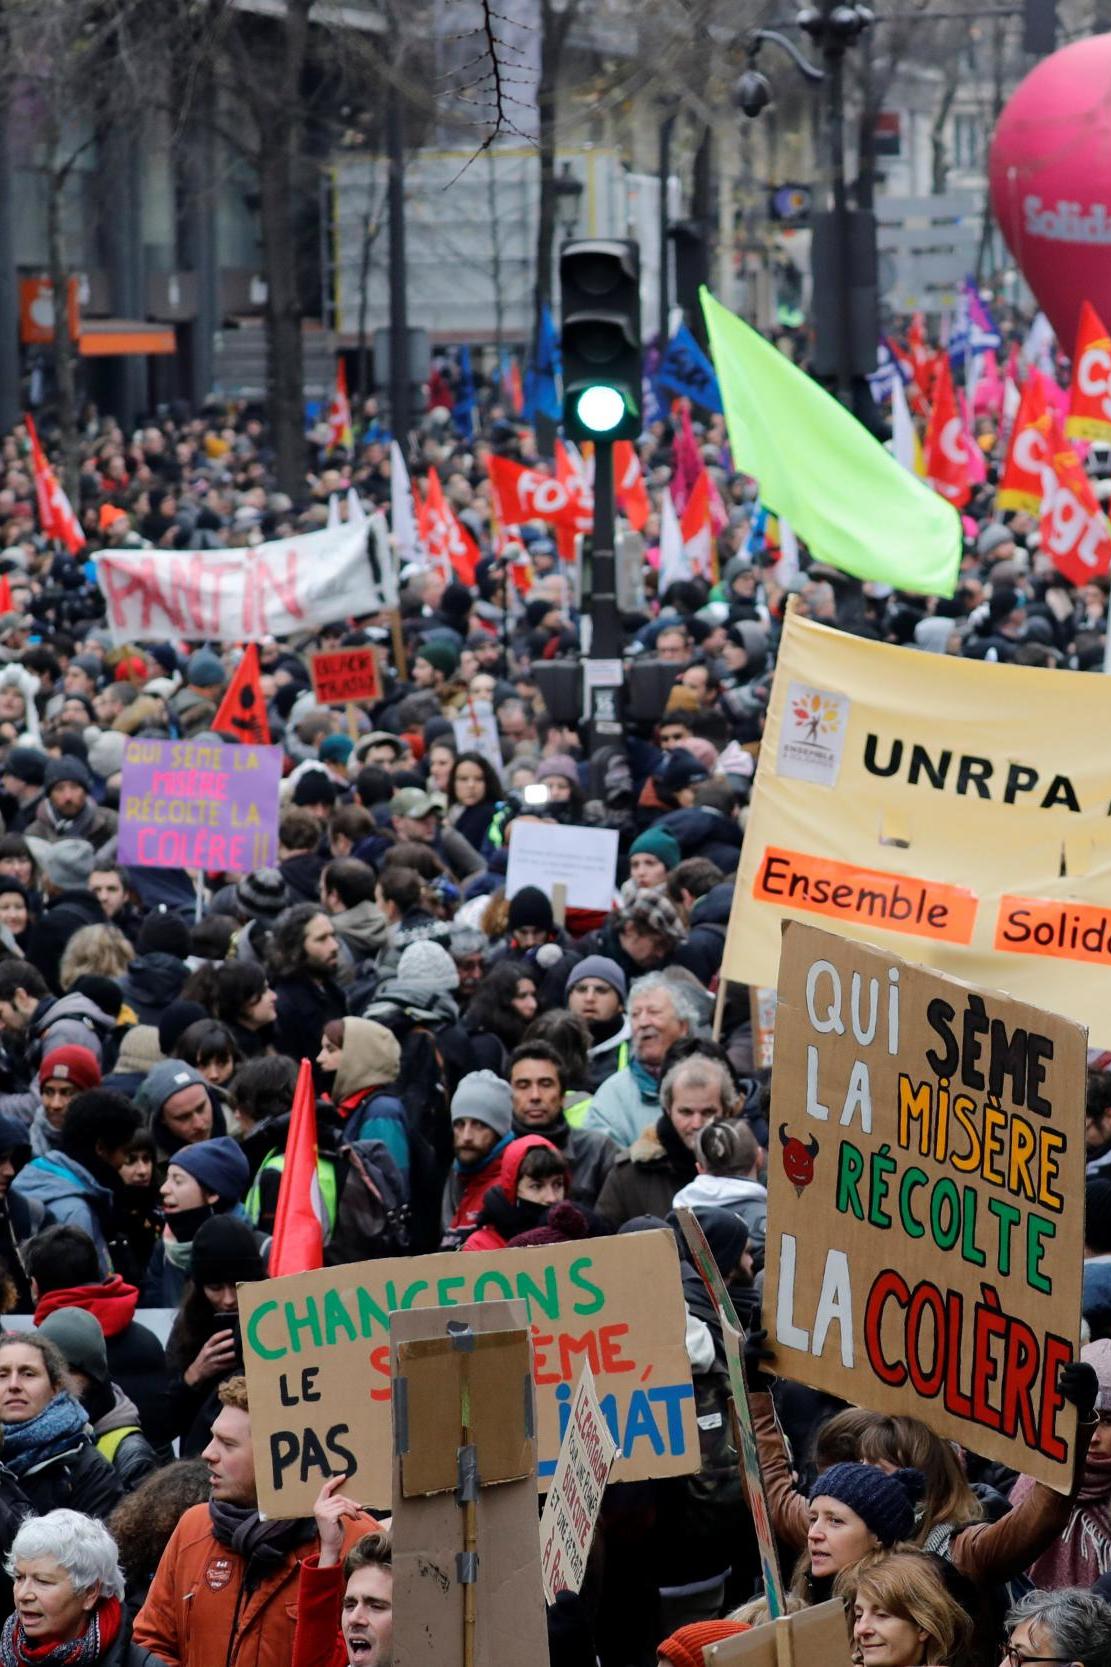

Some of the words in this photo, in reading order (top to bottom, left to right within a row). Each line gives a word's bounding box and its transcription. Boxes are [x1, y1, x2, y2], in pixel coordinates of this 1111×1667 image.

[100, 550, 304, 634] PANTIN
[234, 750, 259, 772] LA
[863, 733, 1082, 814] UNRPA
[231, 803, 260, 828] LA
[761, 856, 949, 929] Ensemble
[805, 1044, 873, 1135] LA
[925, 993, 1054, 1118] SÈME
[836, 1140, 1056, 1295] RÉCOLTE
[279, 1366, 321, 1408] LE
[776, 1232, 855, 1369] LA
[864, 1268, 1073, 1463] COLÈRE
[270, 1423, 358, 1491] PAS
